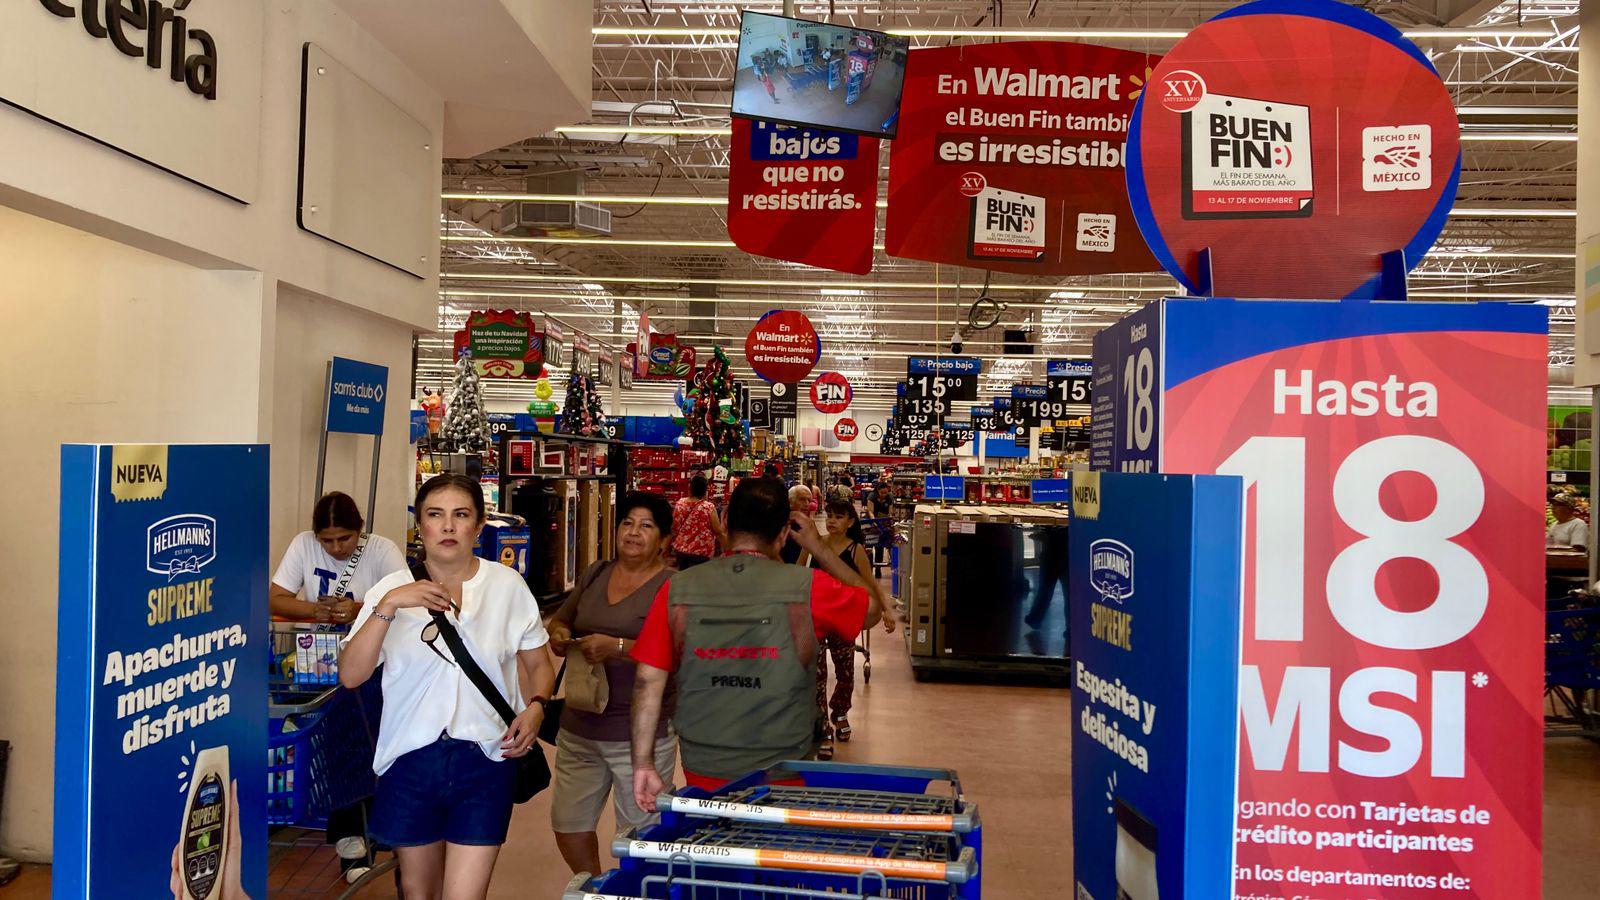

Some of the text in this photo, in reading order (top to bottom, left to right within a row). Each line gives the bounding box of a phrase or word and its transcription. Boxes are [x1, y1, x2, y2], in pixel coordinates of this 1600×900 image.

[937, 66, 1120, 100] En Walmart
[1164, 80, 1199, 96] XV
[945, 107, 1130, 132] el Buen Fin tambi
[1210, 113, 1292, 143] BUEN
[770, 132, 840, 160] bajos
[1373, 134, 1404, 142] HECHO
[938, 140, 974, 162] es
[762, 165, 844, 187] que no
[962, 177, 982, 188] XV
[1373, 172, 1420, 183] MÉXICO
[742, 188, 862, 210] resistirás.
[987, 198, 1036, 218] BUEN
[756, 332, 799, 343] Walmart
[780, 324, 790, 332] En
[1130, 322, 1147, 344] Hasta
[764, 355, 812, 364] irresistible.
[788, 346, 814, 354] también
[927, 360, 973, 370] Precio bajo
[1066, 364, 1092, 372] Precio
[334, 382, 373, 398] sam's club
[816, 384, 846, 400] FIN
[1124, 347, 1154, 451] 18
[1273, 368, 1438, 417] Hasta
[838, 424, 855, 434] FIN
[116, 464, 162, 484] NUEVA
[1074, 486, 1098, 505] NUEVA
[154, 524, 211, 555] HELLMANN'S
[1216, 434, 1489, 650] 18
[1093, 552, 1130, 580] HELLMANN'S
[147, 578, 213, 627] SUPREME
[1091, 602, 1133, 652] SUPREME
[102, 624, 247, 686] Apachurra,
[116, 657, 237, 720] muerde y
[712, 675, 761, 689] PRENSA
[1076, 660, 1157, 735] Espesita y
[122, 693, 230, 756] disfruta
[1081, 705, 1149, 774] deliciosa
[191, 804, 221, 829] SUPREME
[1238, 798, 1490, 826] gando con Tarjetas de
[1235, 824, 1474, 853] crédito participantes
[693, 846, 730, 856] GRATIS
[1255, 864, 1284, 881] los
[1286, 866, 1436, 888] departamentos
[1439, 872, 1470, 890] de:
